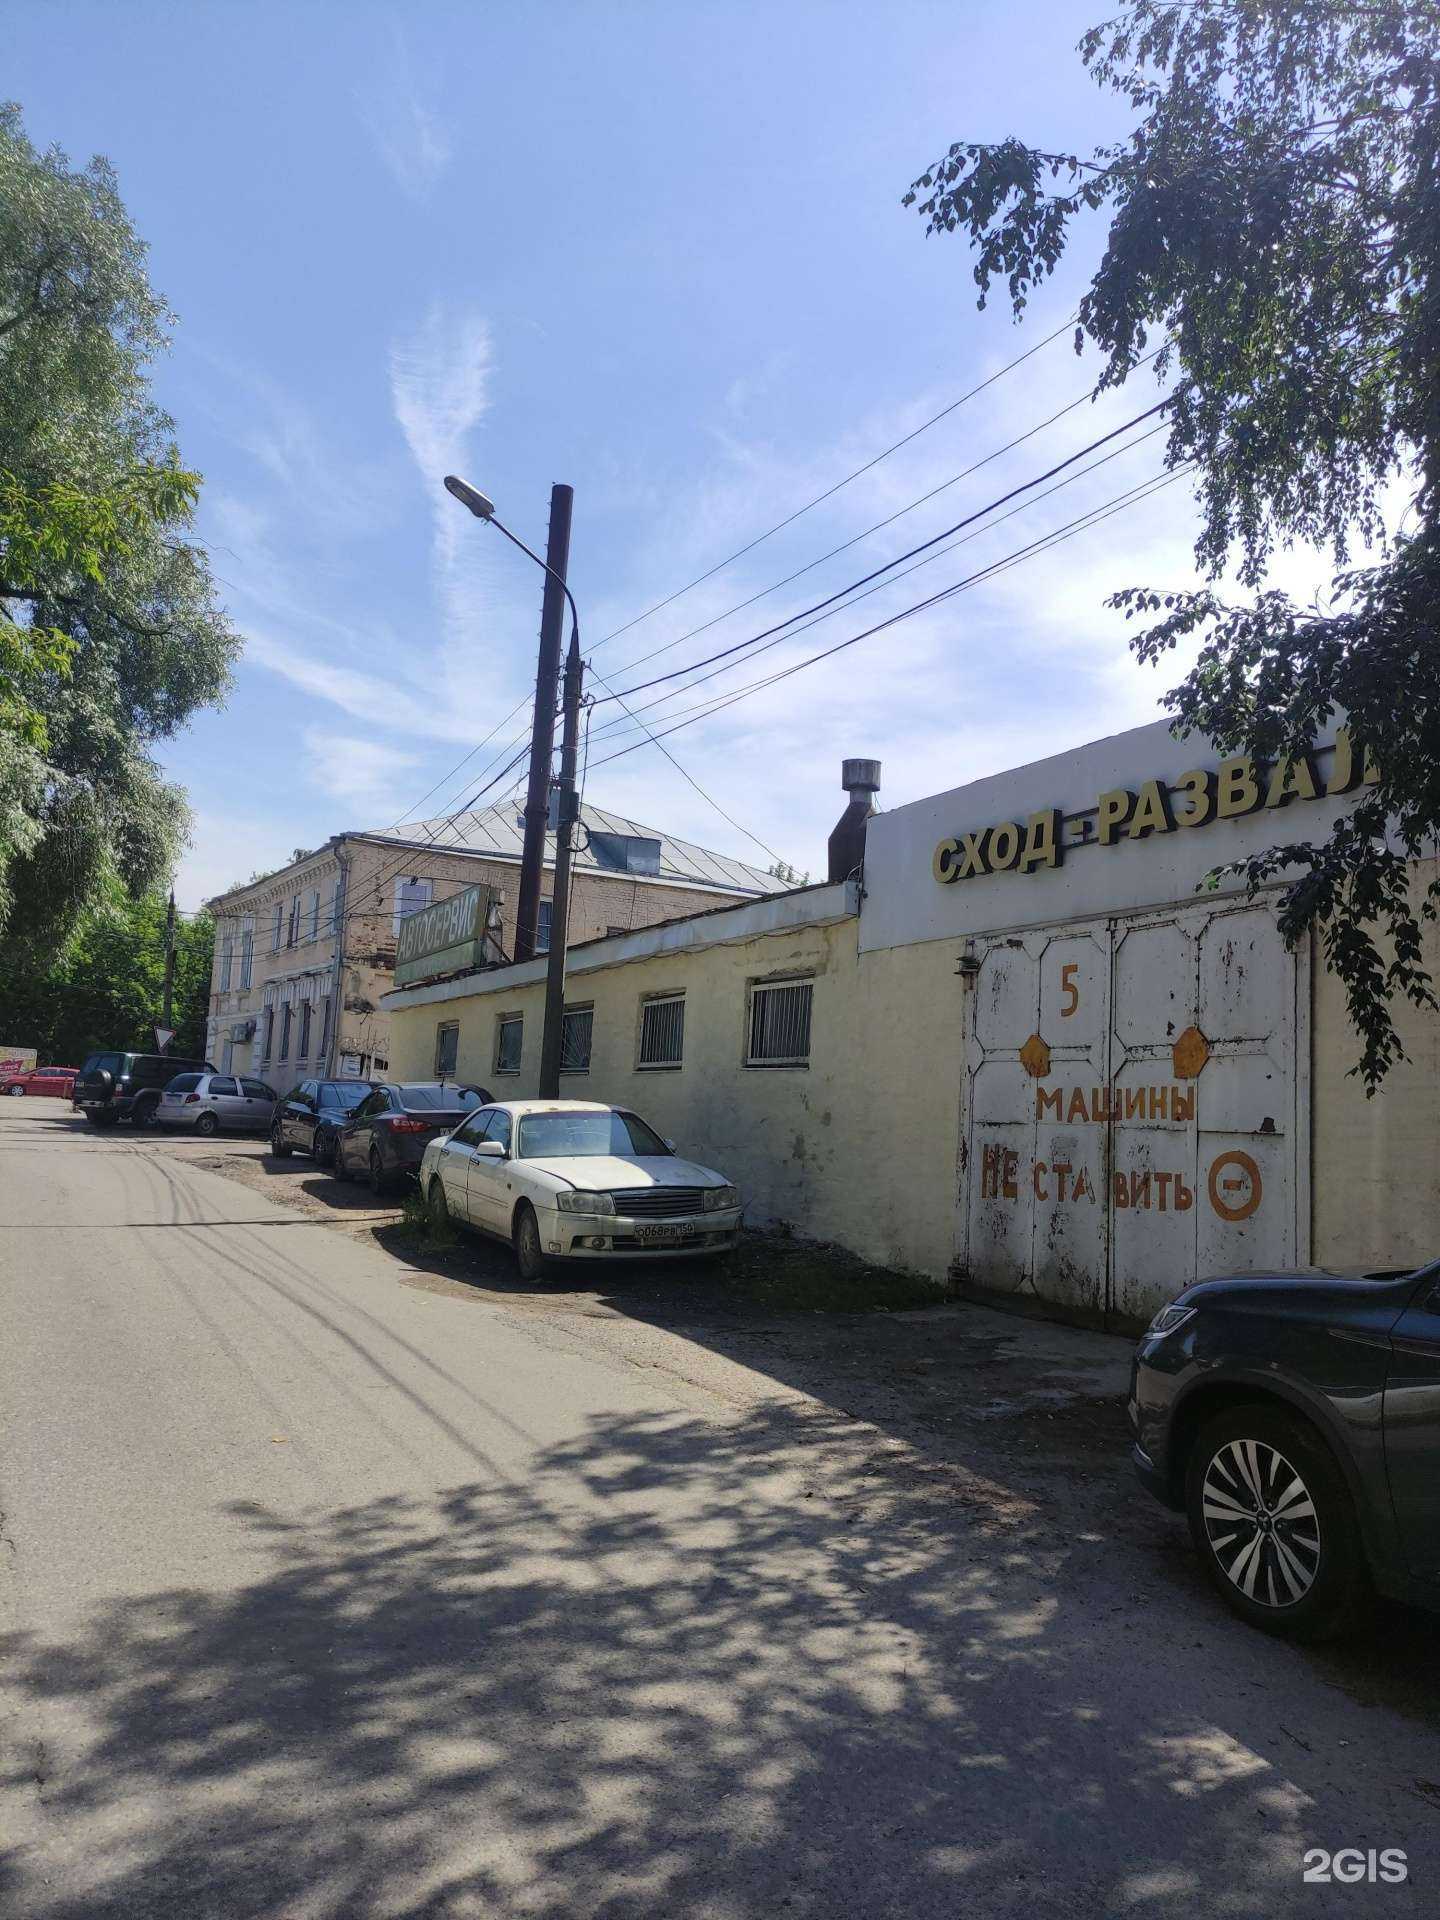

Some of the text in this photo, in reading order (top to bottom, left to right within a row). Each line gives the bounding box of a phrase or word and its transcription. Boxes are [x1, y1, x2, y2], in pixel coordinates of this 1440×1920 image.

[400, 890, 478, 961] АВТОСЕРВИС
[1060, 964, 1079, 1017] 5
[1036, 1086, 1195, 1123] МАШИНЫ
[981, 1143, 1019, 1199] НЕ
